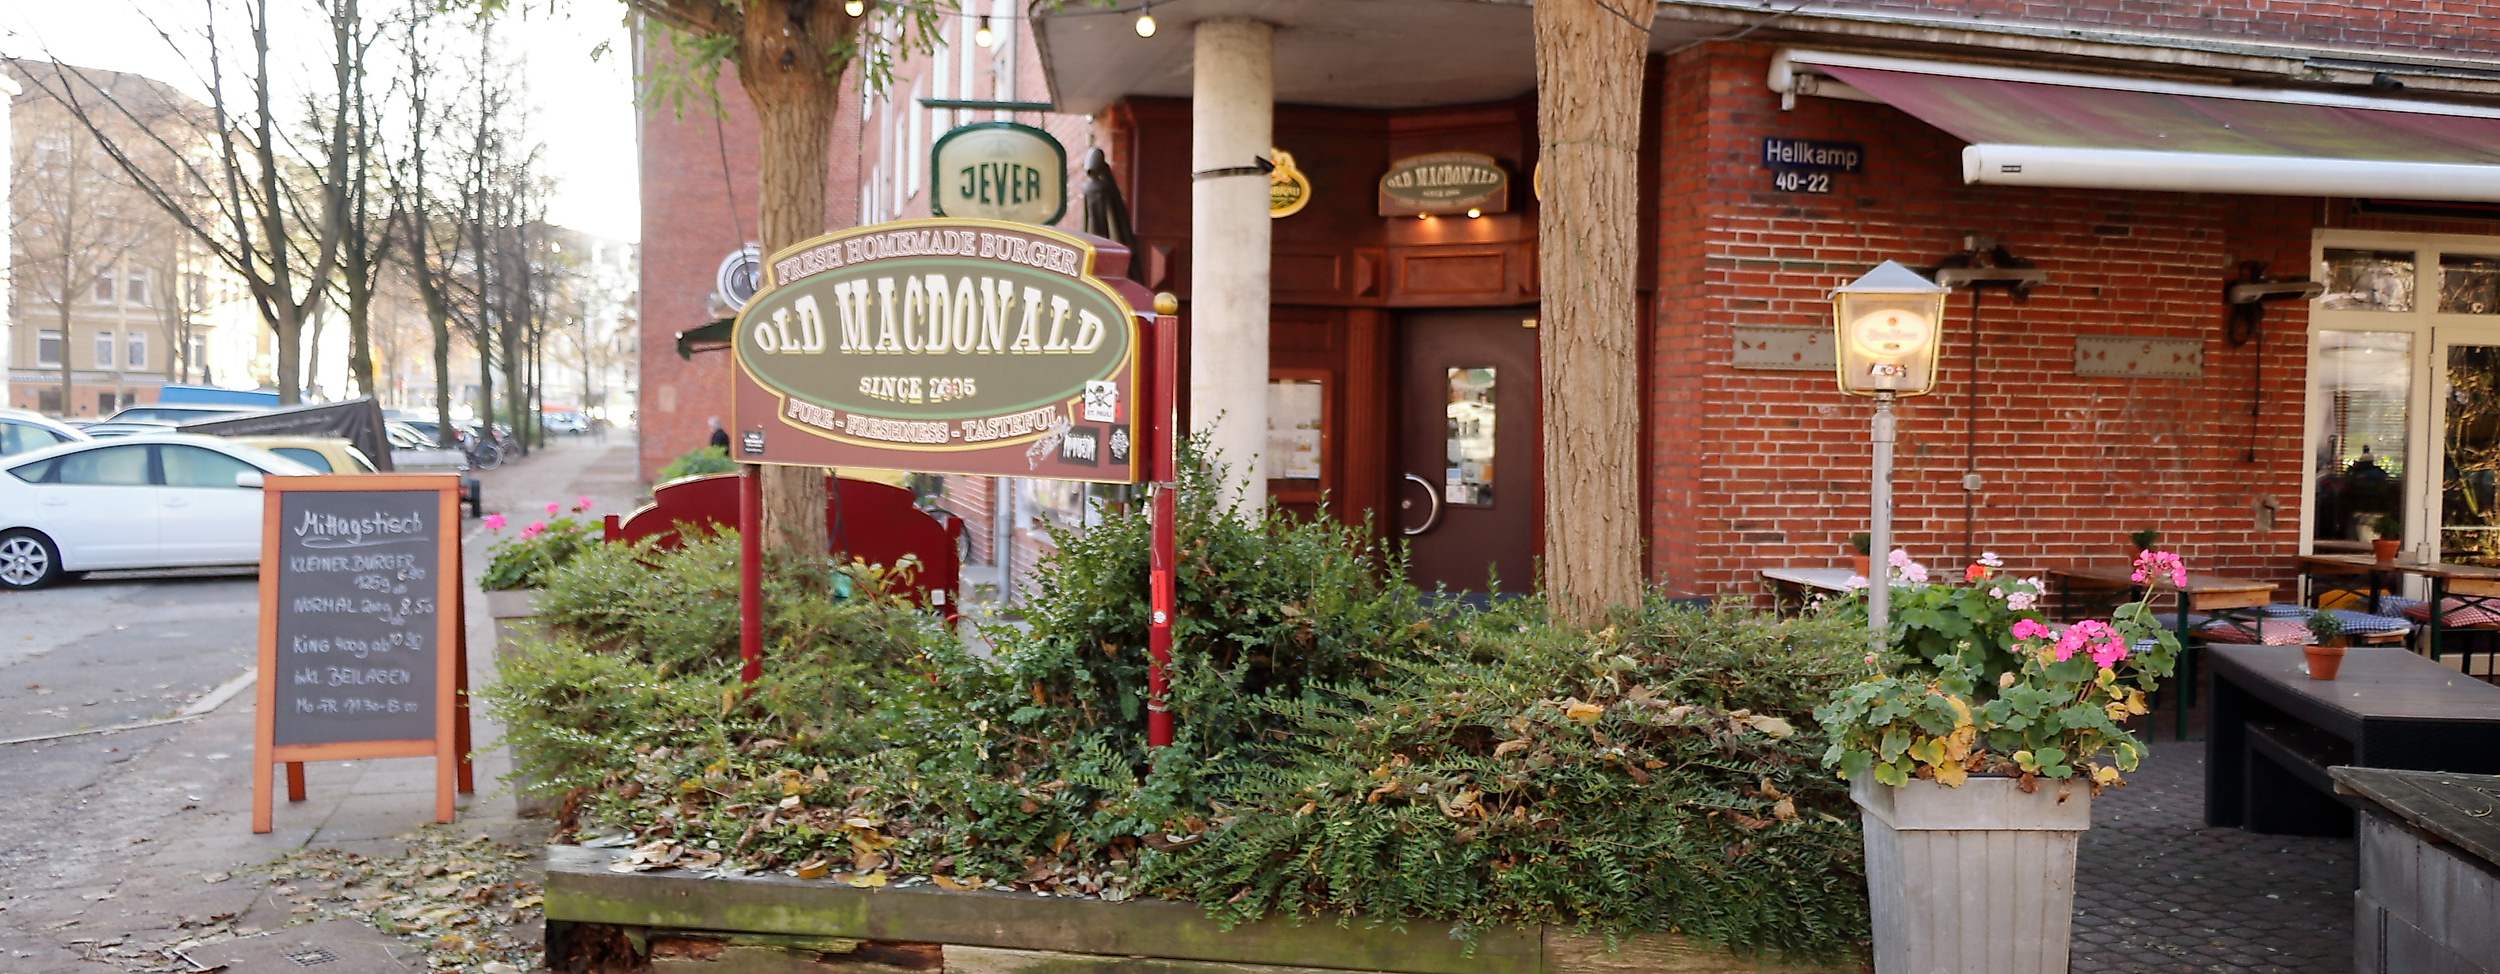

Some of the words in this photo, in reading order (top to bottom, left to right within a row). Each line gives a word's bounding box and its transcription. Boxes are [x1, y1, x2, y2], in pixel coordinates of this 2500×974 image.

[1766, 139, 1858, 171] Hellkamp
[961, 162, 1040, 206] JEVER
[1386, 170, 1413, 188] OLD
[1414, 165, 1499, 187] MACDONALD
[1775, 172, 1829, 193] 40-22
[775, 242, 843, 286] FRESH
[845, 230, 977, 264] HOMEMADE
[979, 233, 1079, 277] BURGER
[753, 294, 826, 355] OLD
[833, 273, 1108, 355] MACDONALD
[859, 376, 923, 404] SINCE
[787, 398, 835, 431] PURE
[845, 413, 950, 444] FRESHNESS
[961, 405, 1063, 443] TASTEFUL
[294, 510, 423, 545] Mittagstisch
[289, 555, 350, 573] KLEINER
[350, 553, 415, 571] BURGER
[293, 597, 358, 614] NORMAL
[325, 665, 411, 688] BEILAGEN
